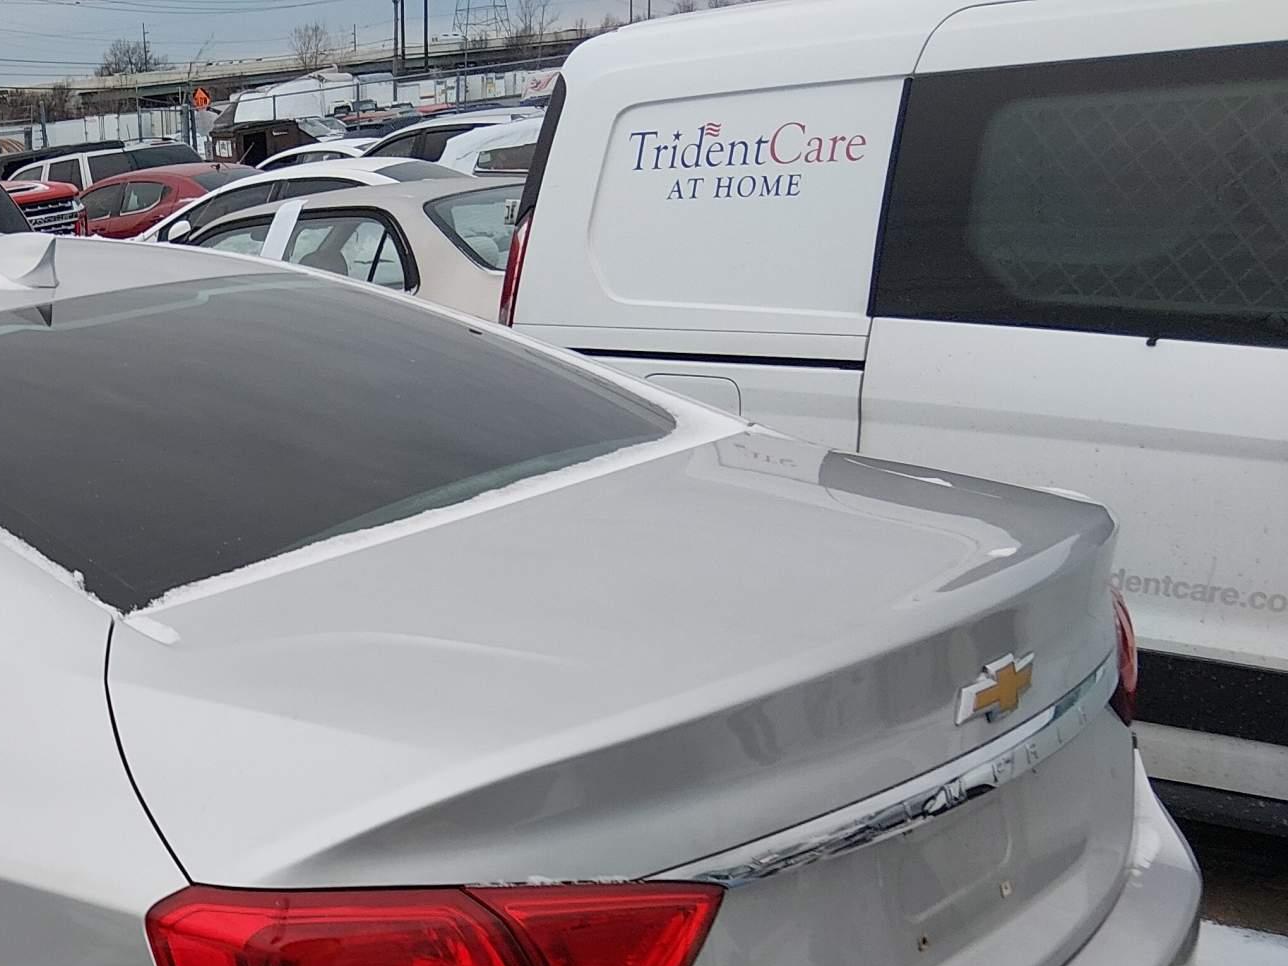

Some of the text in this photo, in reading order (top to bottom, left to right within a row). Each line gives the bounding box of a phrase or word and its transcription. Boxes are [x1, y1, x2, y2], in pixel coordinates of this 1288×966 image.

[629, 122, 867, 171] TridentCare
[666, 174, 803, 200] AT HOME
